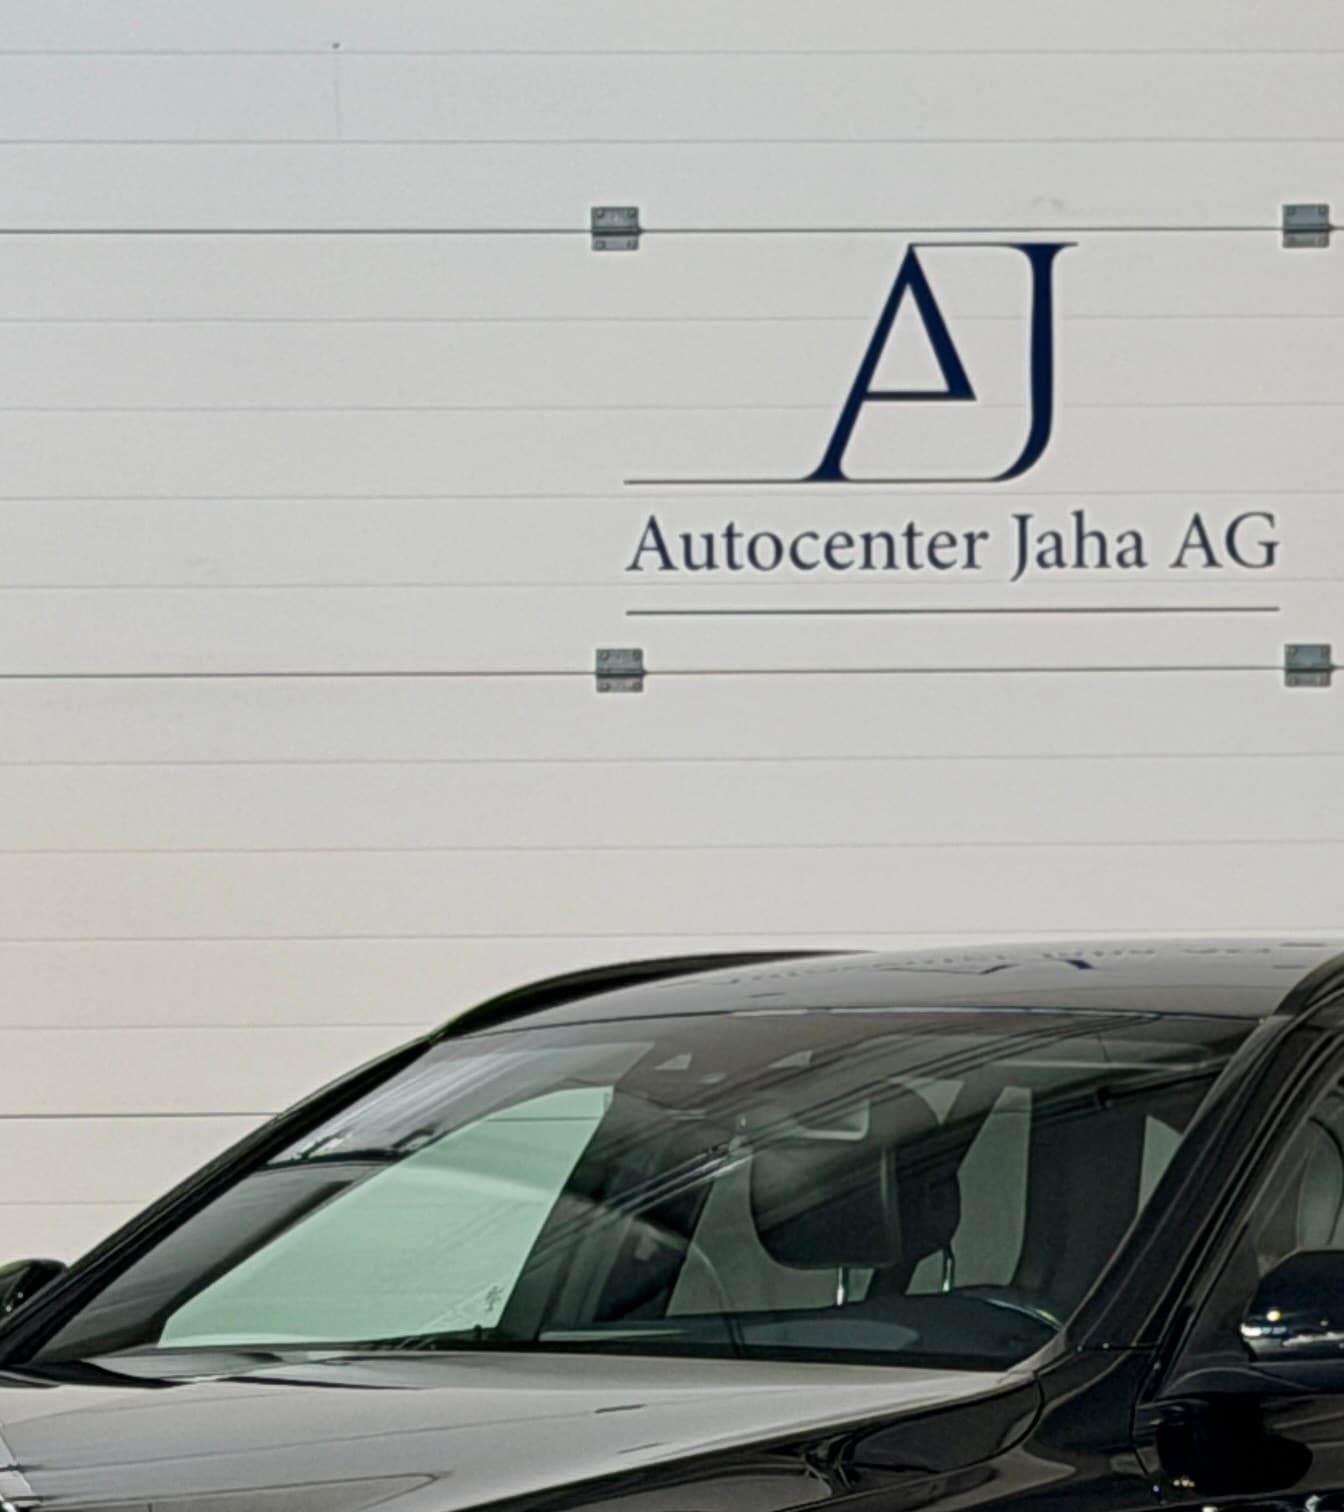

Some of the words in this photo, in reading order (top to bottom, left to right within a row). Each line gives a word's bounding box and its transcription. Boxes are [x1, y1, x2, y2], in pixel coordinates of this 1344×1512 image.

[802, 241, 1078, 482] AJ
[624, 513, 990, 572] Autocenter
[1009, 510, 1148, 582] Jaha
[1169, 510, 1281, 570] AG
